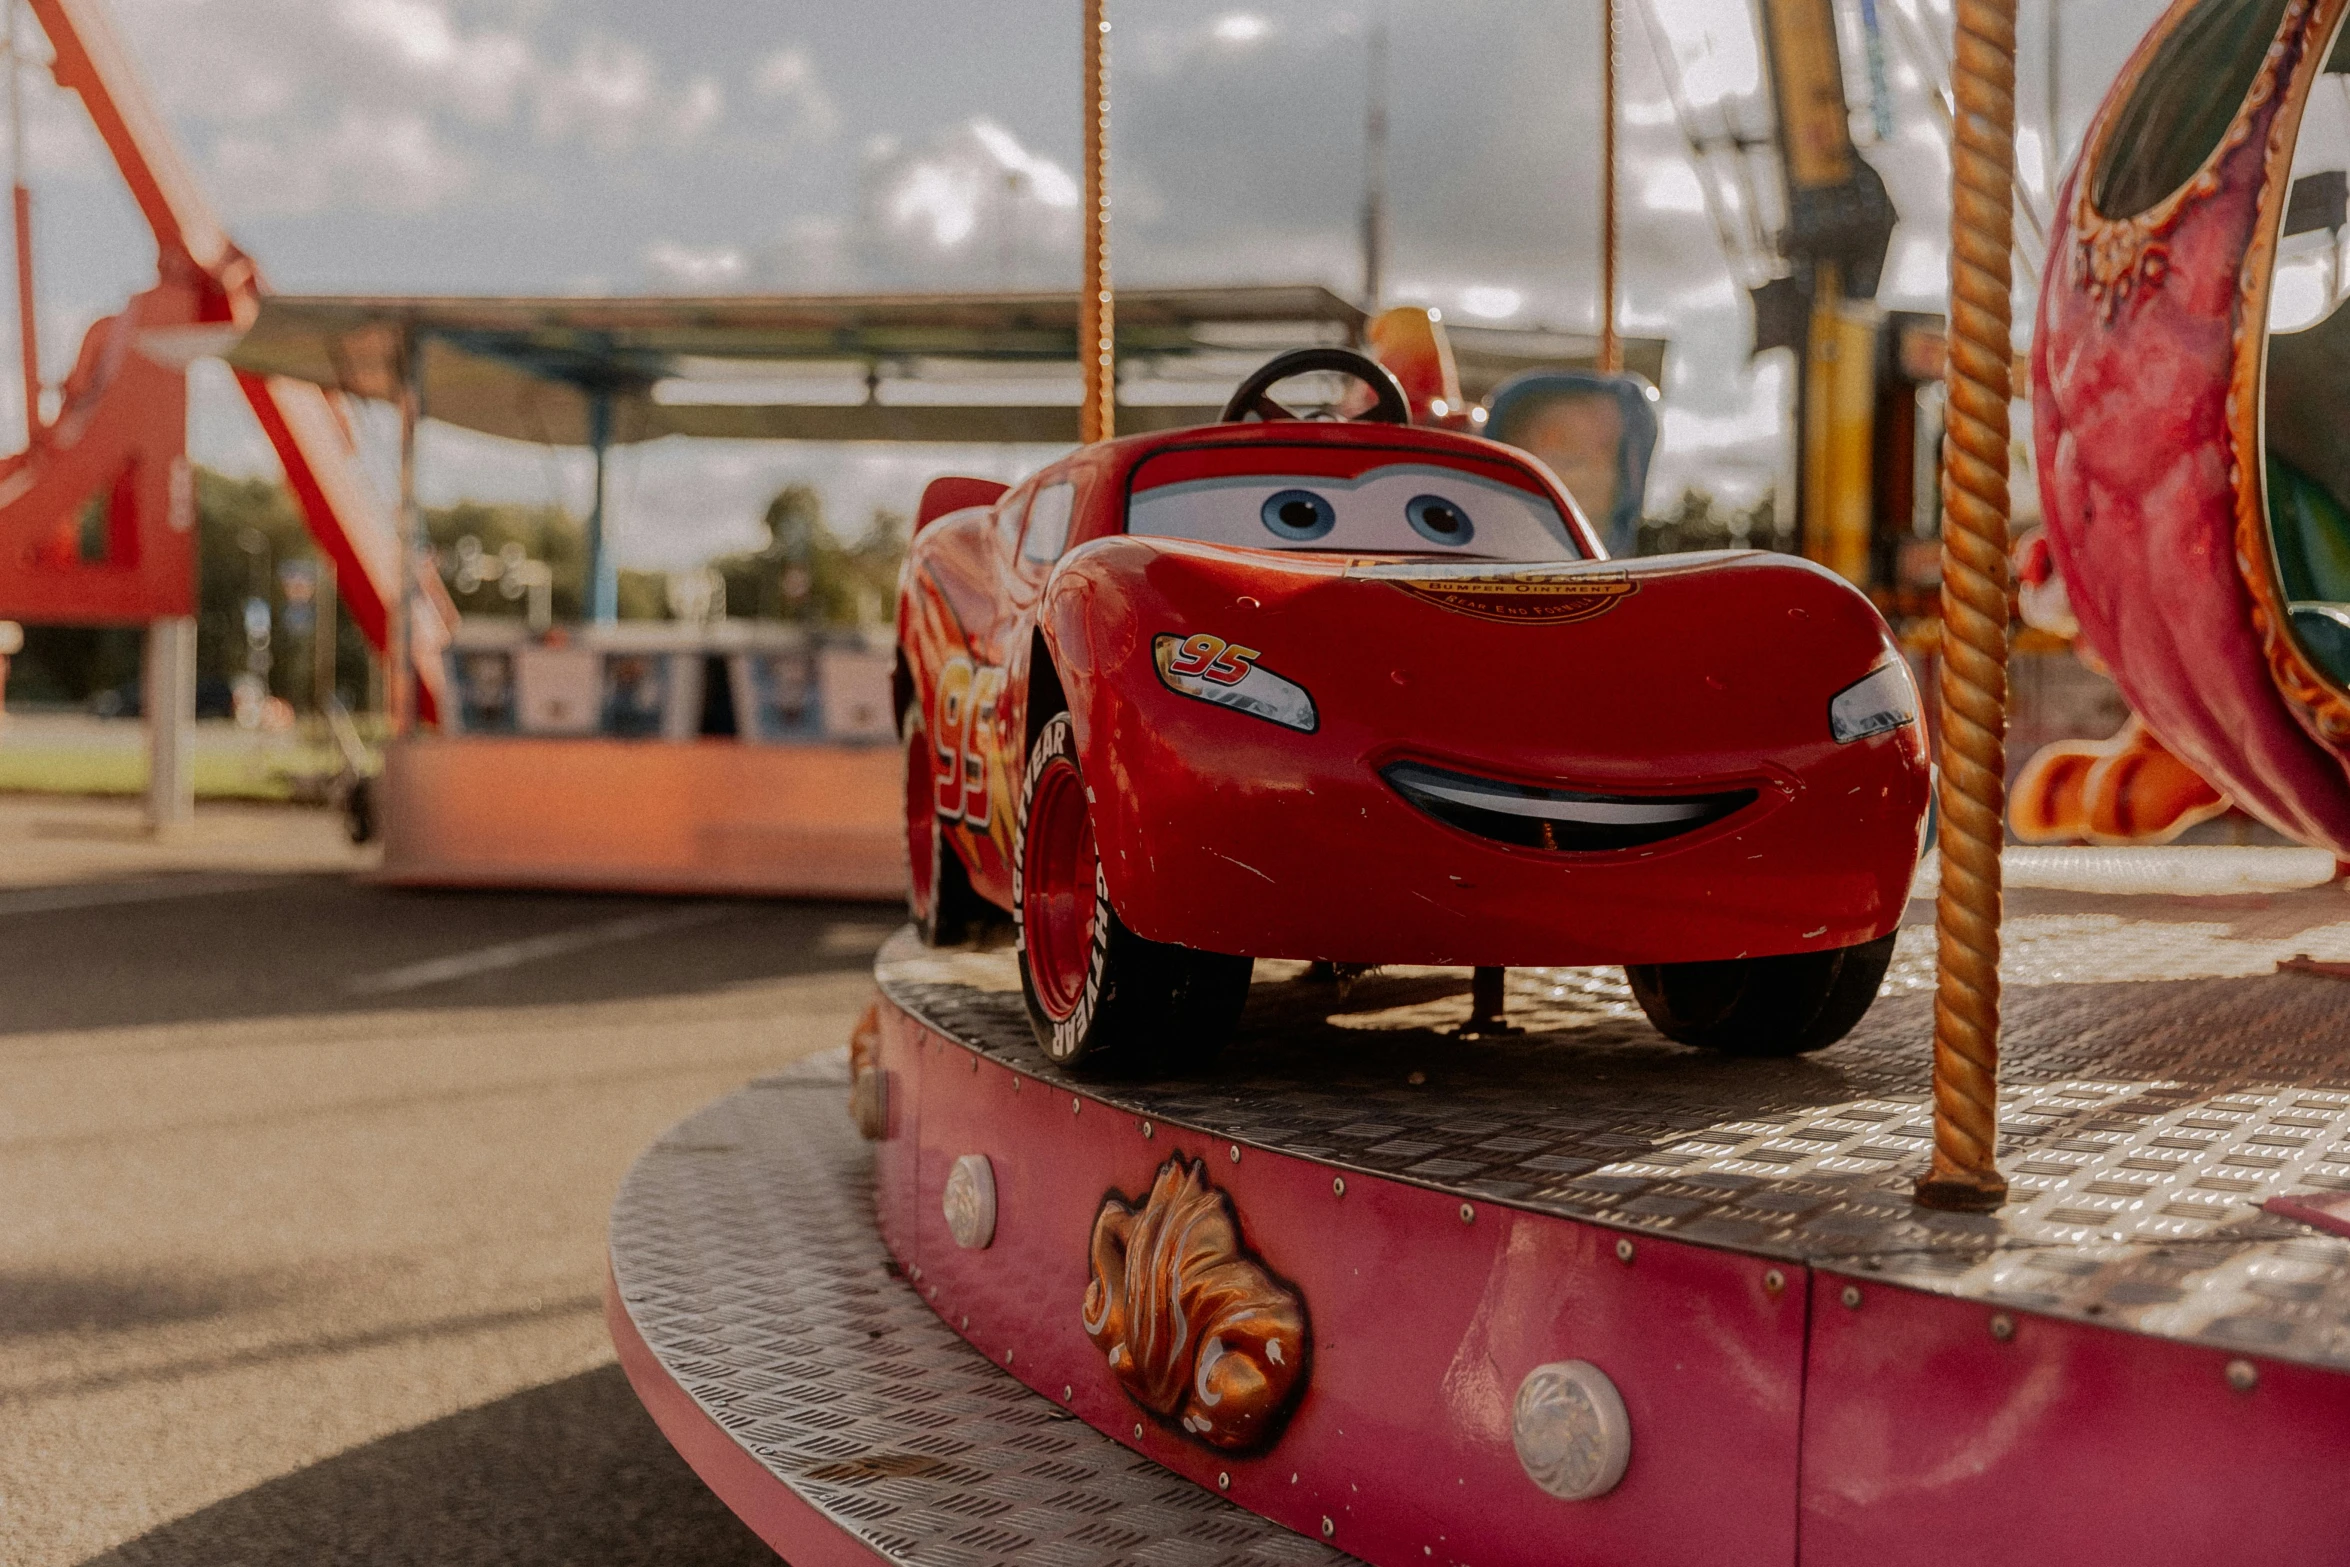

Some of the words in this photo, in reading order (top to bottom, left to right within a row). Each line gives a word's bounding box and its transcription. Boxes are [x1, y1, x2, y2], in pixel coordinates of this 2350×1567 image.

[1428, 582, 1505, 592] BUMPER
[1515, 585, 1613, 593] OINTMENT
[1445, 594, 1487, 610] REAR
[1495, 605, 1528, 615] END
[1169, 633, 1262, 687] 95
[933, 656, 1007, 835] 95
[1012, 721, 1066, 951] LIGHTYEAR
[1052, 842, 1109, 1057] GHTYEAR
